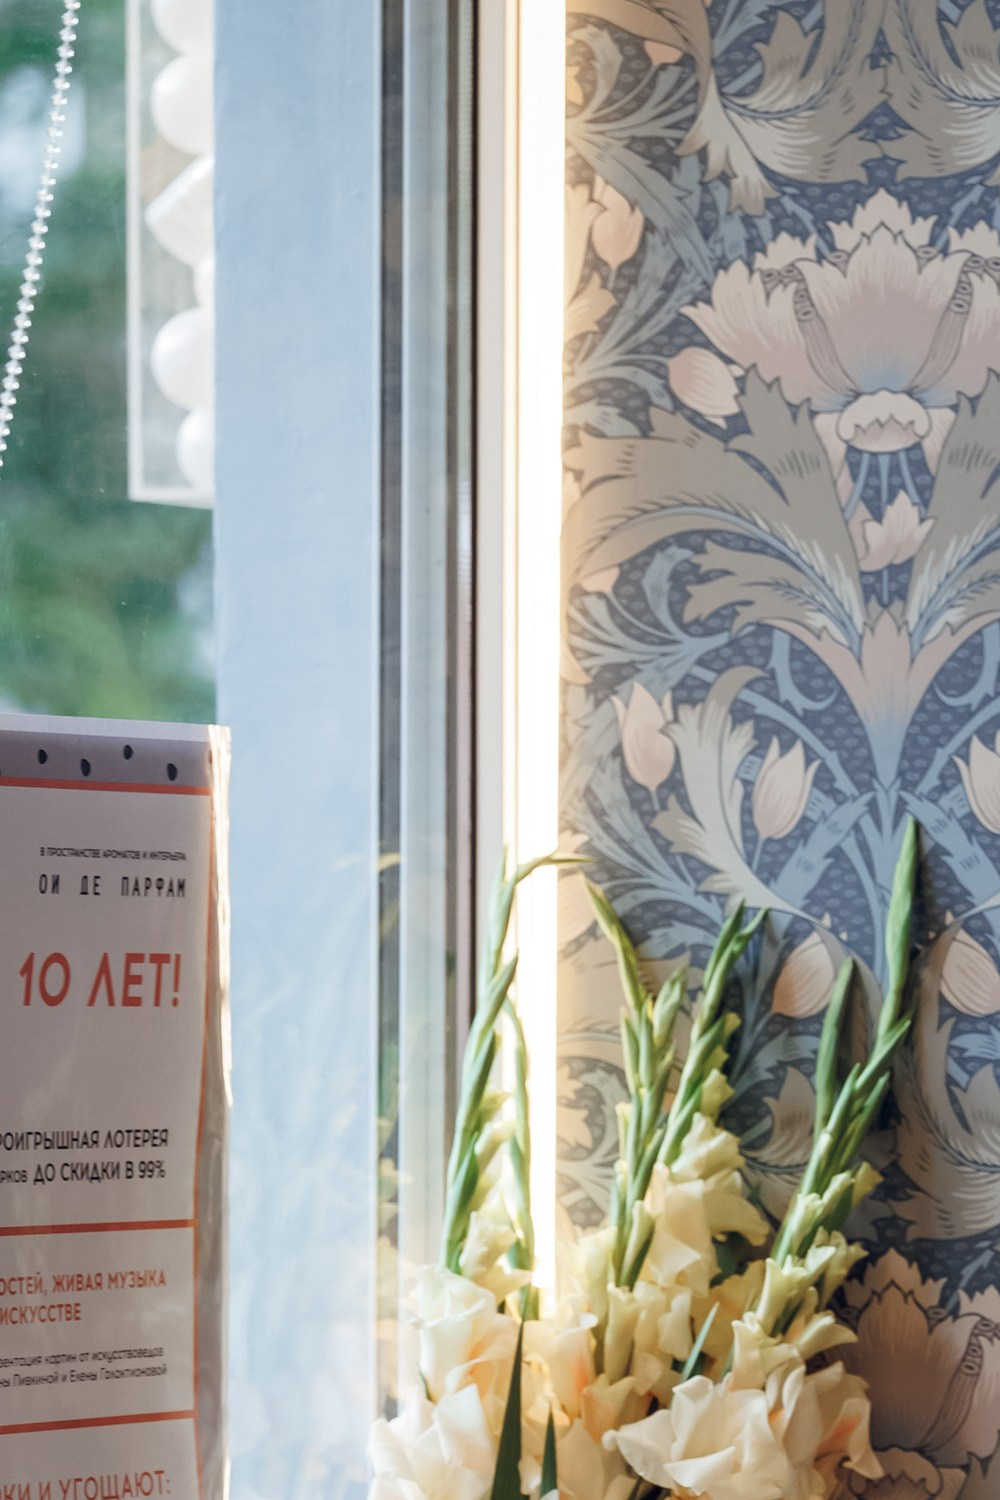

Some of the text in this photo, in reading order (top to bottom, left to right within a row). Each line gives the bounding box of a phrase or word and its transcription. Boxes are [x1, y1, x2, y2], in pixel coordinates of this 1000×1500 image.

[39, 874, 186, 897] ОИ ДЕ ПАРФАМ
[19, 952, 182, 1008] 10 ЛЕТ!
[0, 1129, 168, 1151] ОИГРЫШНАЯ ЛОТЕРЕЯ
[33, 1163, 56, 1185] ДО
[60, 1161, 120, 1184] СКИДКИ
[125, 1161, 134, 1179] В
[139, 1160, 166, 1179] 99%
[52, 1272, 103, 1293] ЖИВАЯ
[108, 1269, 167, 1290] МУЗЫКА
[0, 1303, 81, 1325] ИСКУССТВЕ
